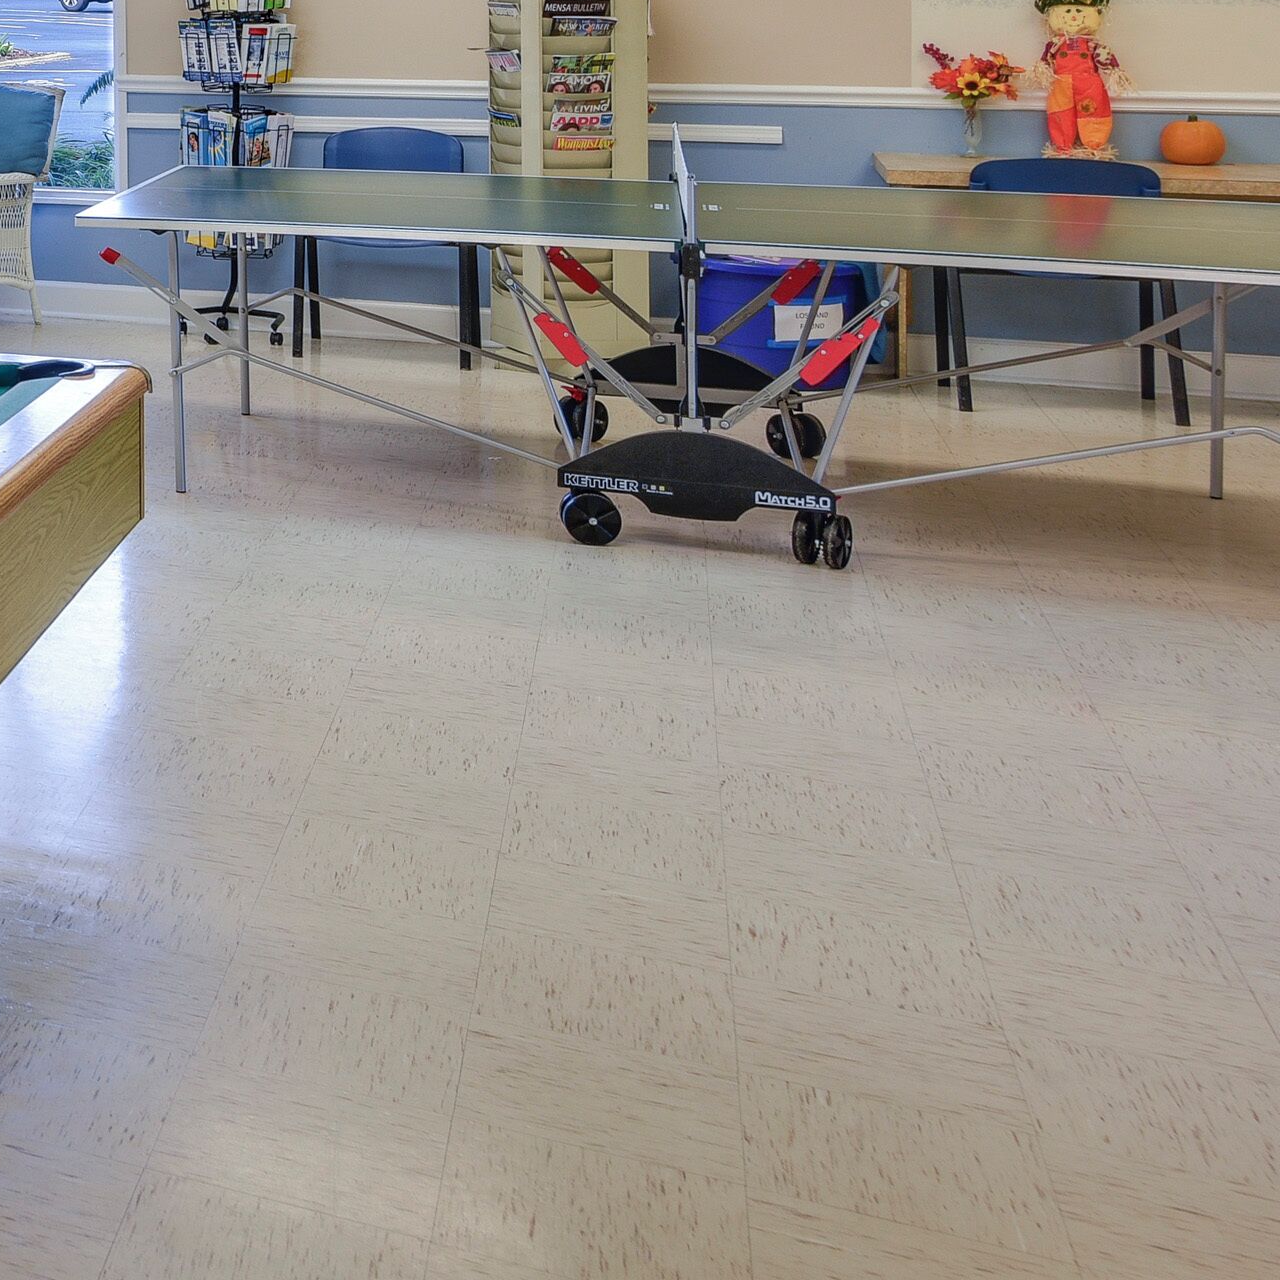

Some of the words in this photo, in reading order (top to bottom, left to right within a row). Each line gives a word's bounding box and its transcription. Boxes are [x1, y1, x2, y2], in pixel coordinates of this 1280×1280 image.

[572, 3, 606, 12] BULLETIN
[550, 75, 606, 84] GLAMOUR
[574, 104, 608, 113] LIVING
[563, 473, 639, 492] KETTLER
